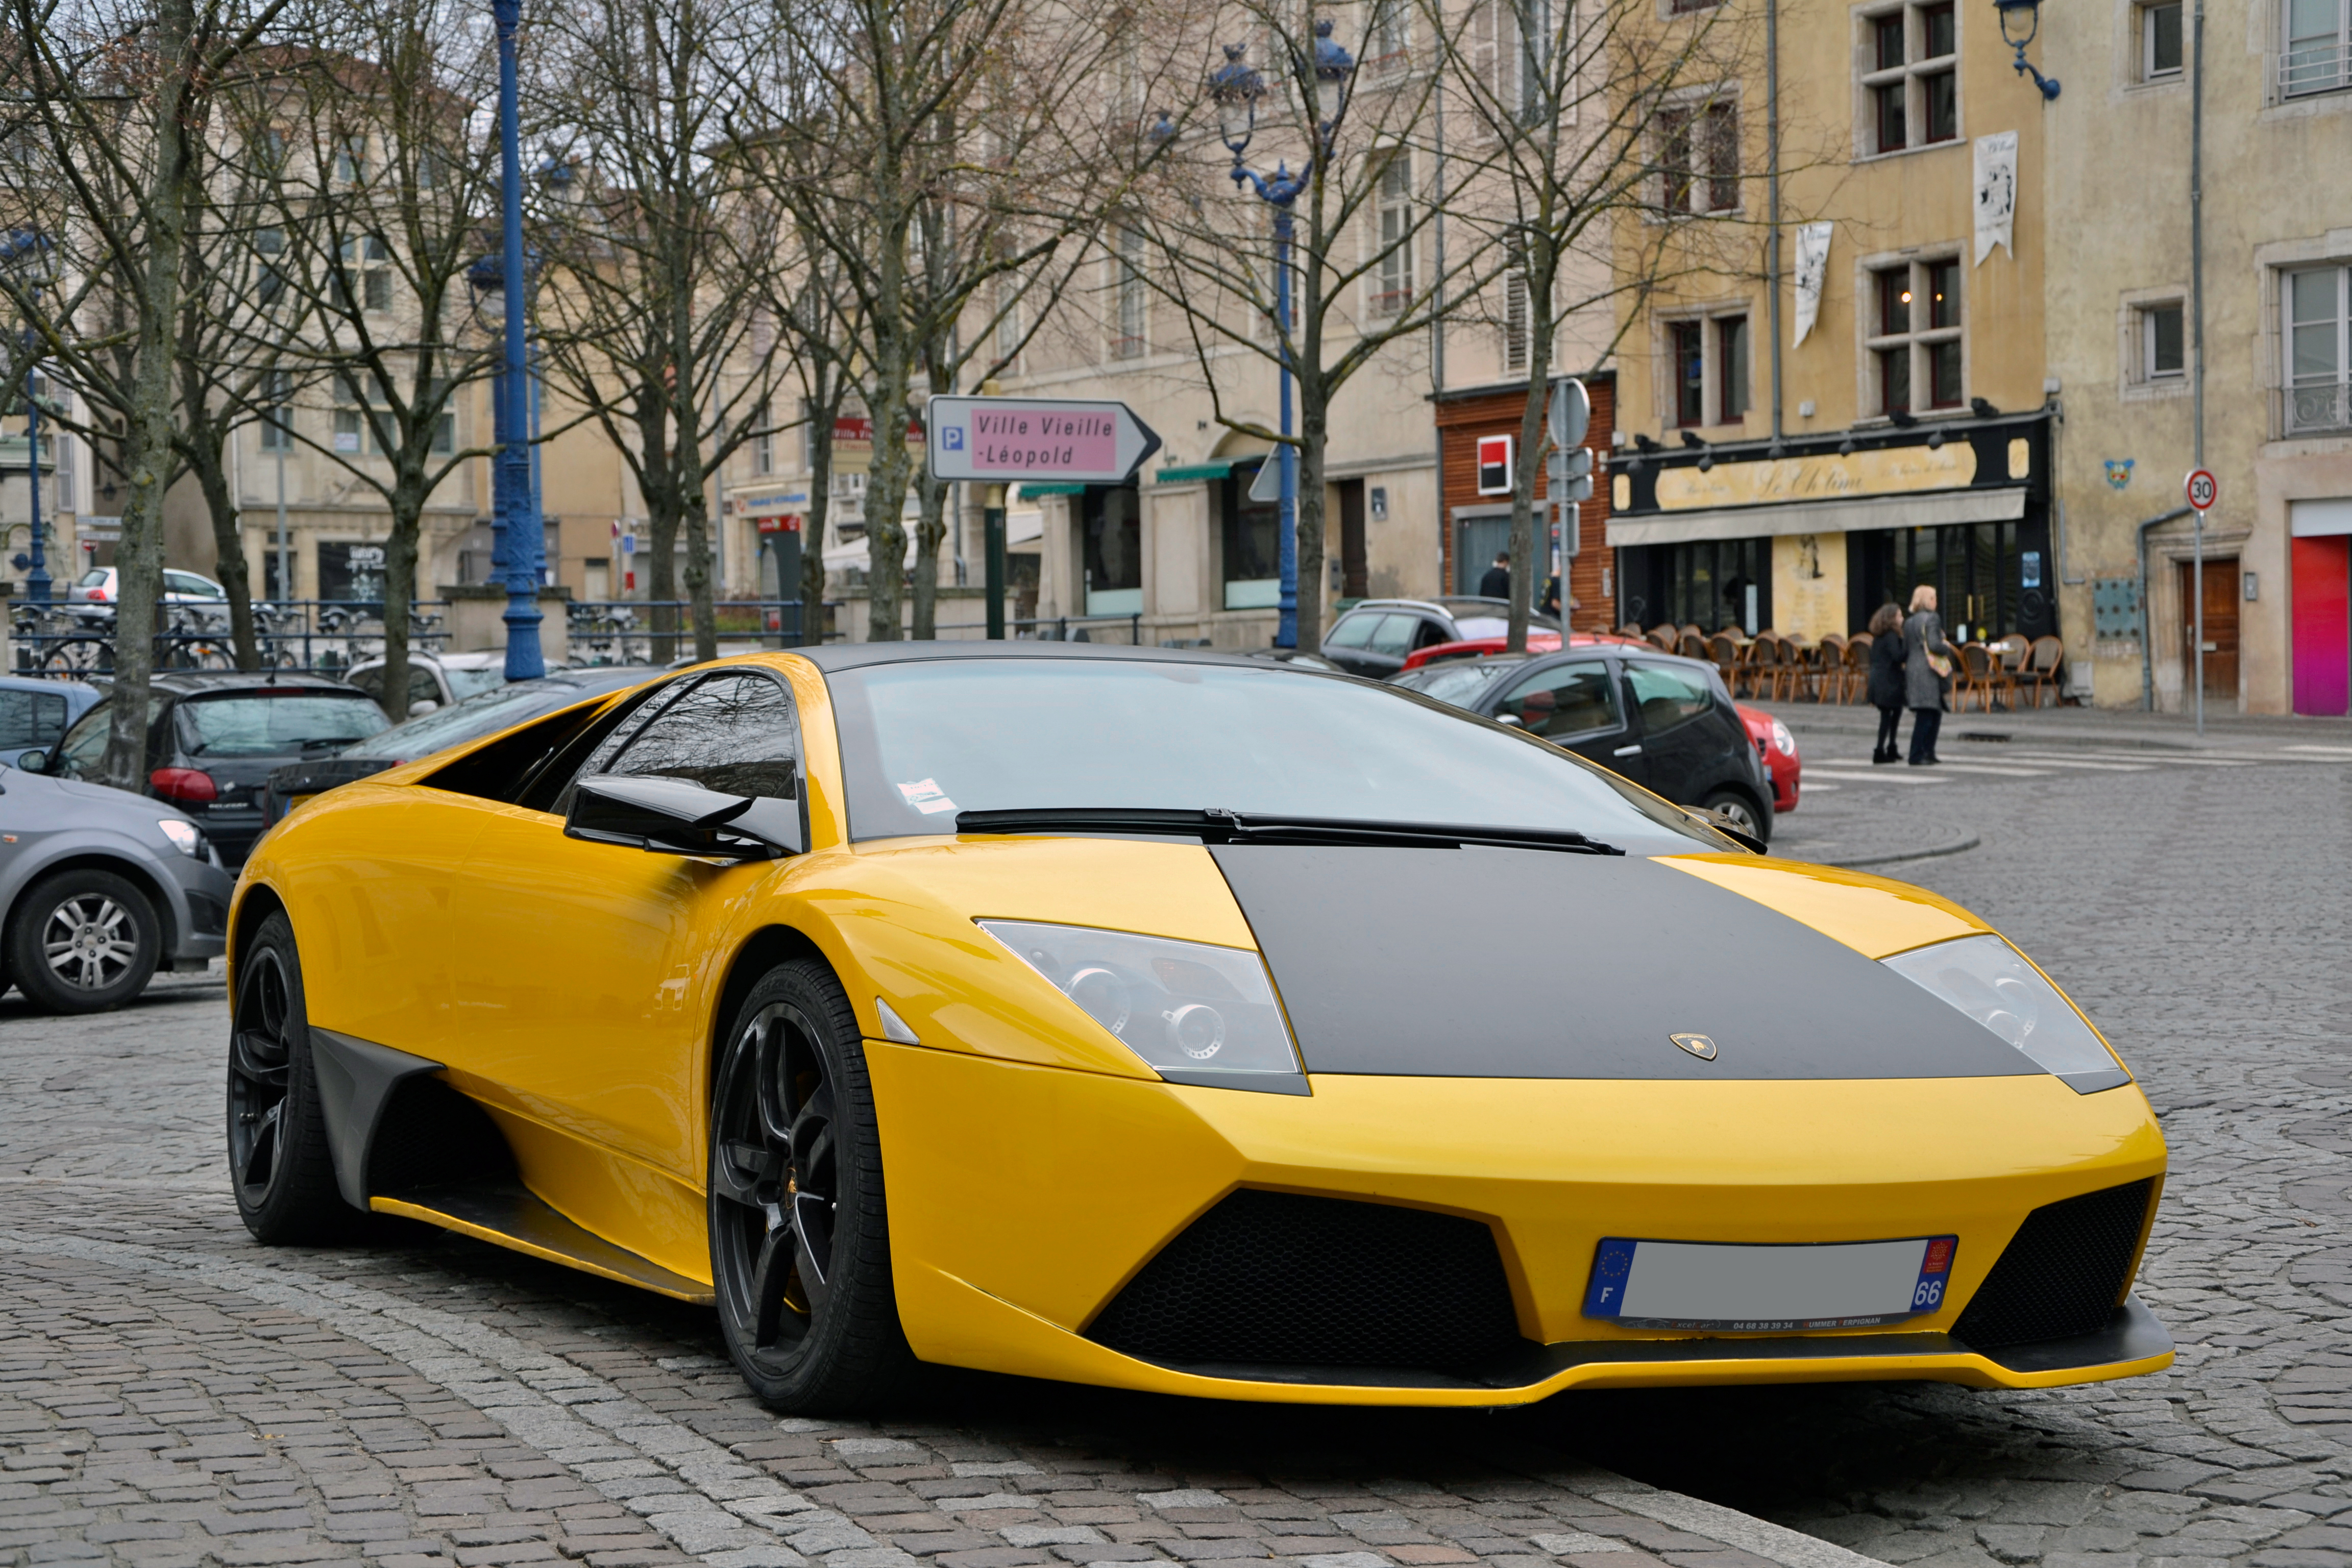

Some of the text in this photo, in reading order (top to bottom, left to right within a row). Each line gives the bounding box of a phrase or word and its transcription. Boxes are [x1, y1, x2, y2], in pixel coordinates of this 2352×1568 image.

[979, 415, 1113, 437] Ville Vieille
[946, 429, 960, 449] P
[2193, 481, 2212, 498] 30
[1601, 1287, 1613, 1303] F
[1915, 1280, 1942, 1305] 66
[1803, 1317, 1880, 1328] HUMMER PERPIGNAN
